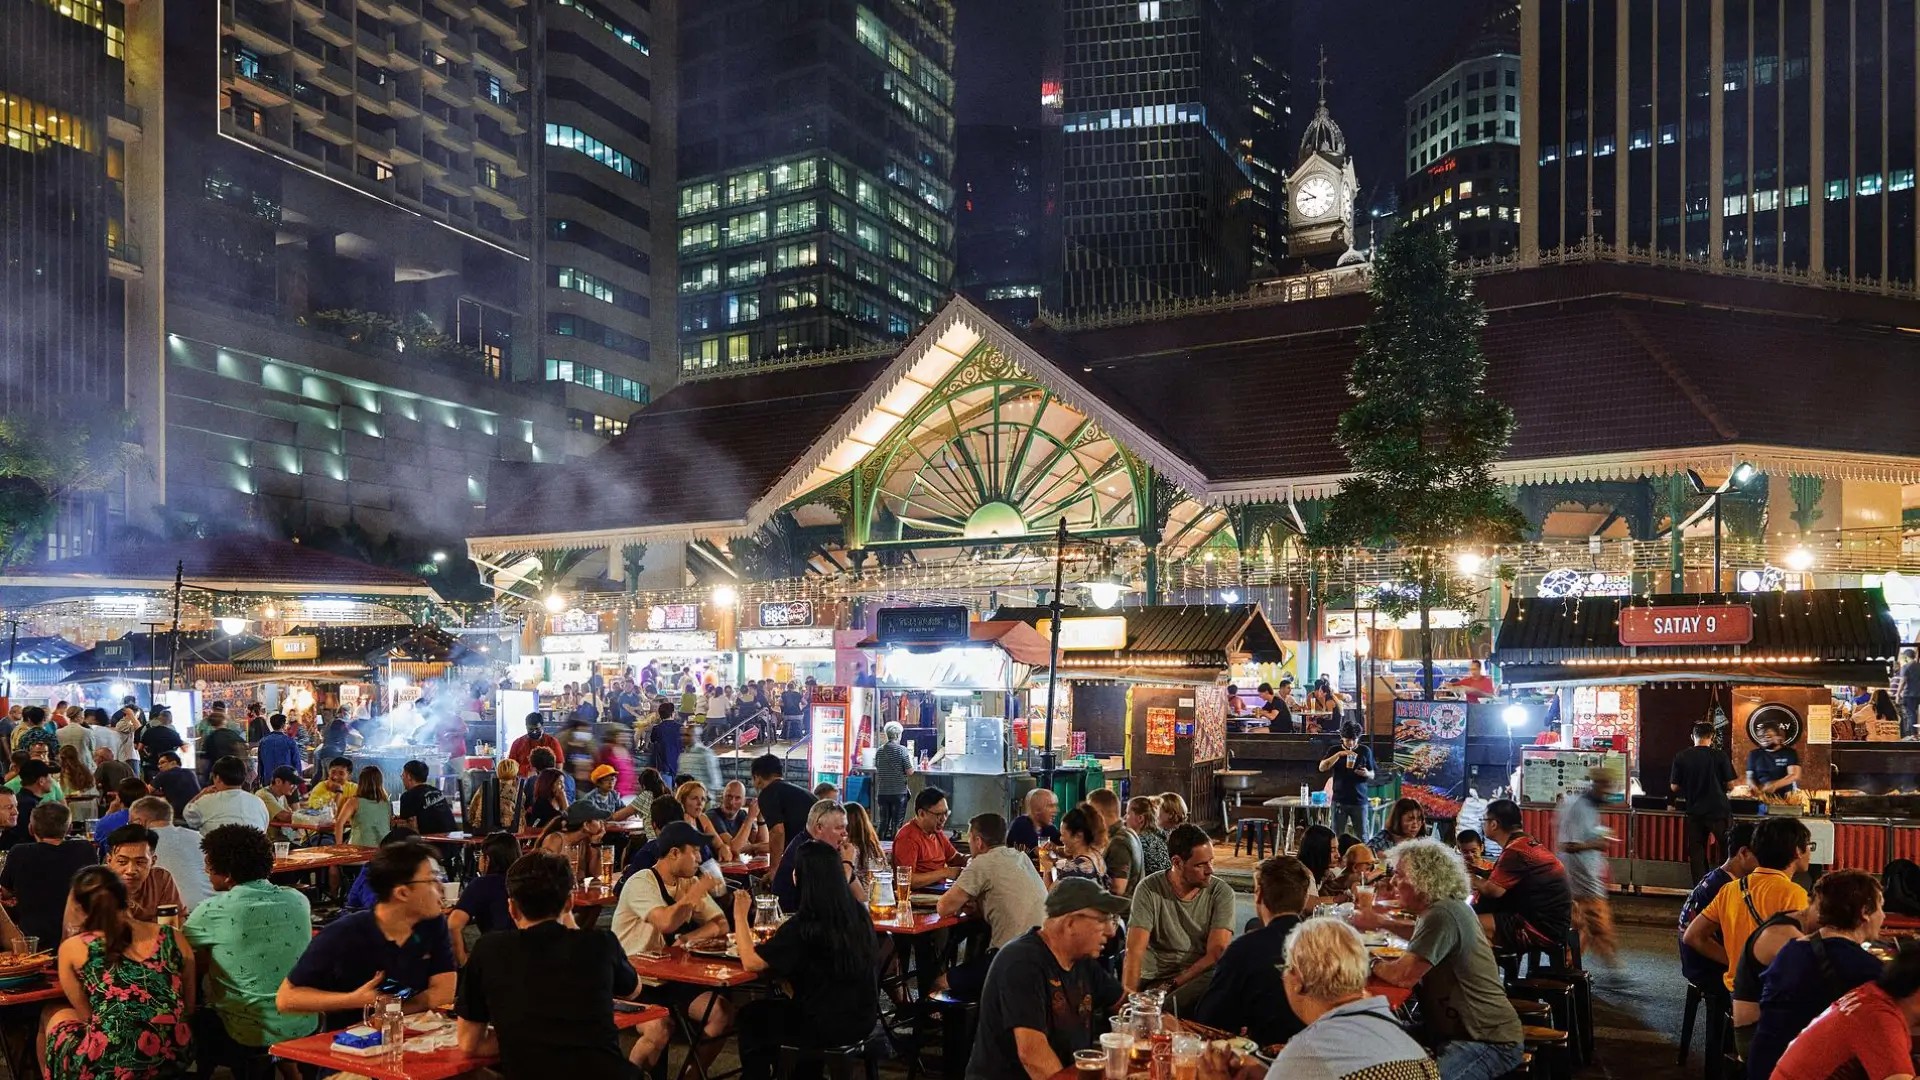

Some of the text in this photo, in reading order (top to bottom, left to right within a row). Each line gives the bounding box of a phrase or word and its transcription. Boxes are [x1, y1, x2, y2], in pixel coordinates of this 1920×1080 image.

[1606, 575, 1628, 583] BBQ
[1587, 583, 1629, 591] SEAFOOD
[765, 609, 787, 621] BBQ
[1653, 616, 1716, 634] SATAY 9
[1756, 722, 1791, 730] SAY
